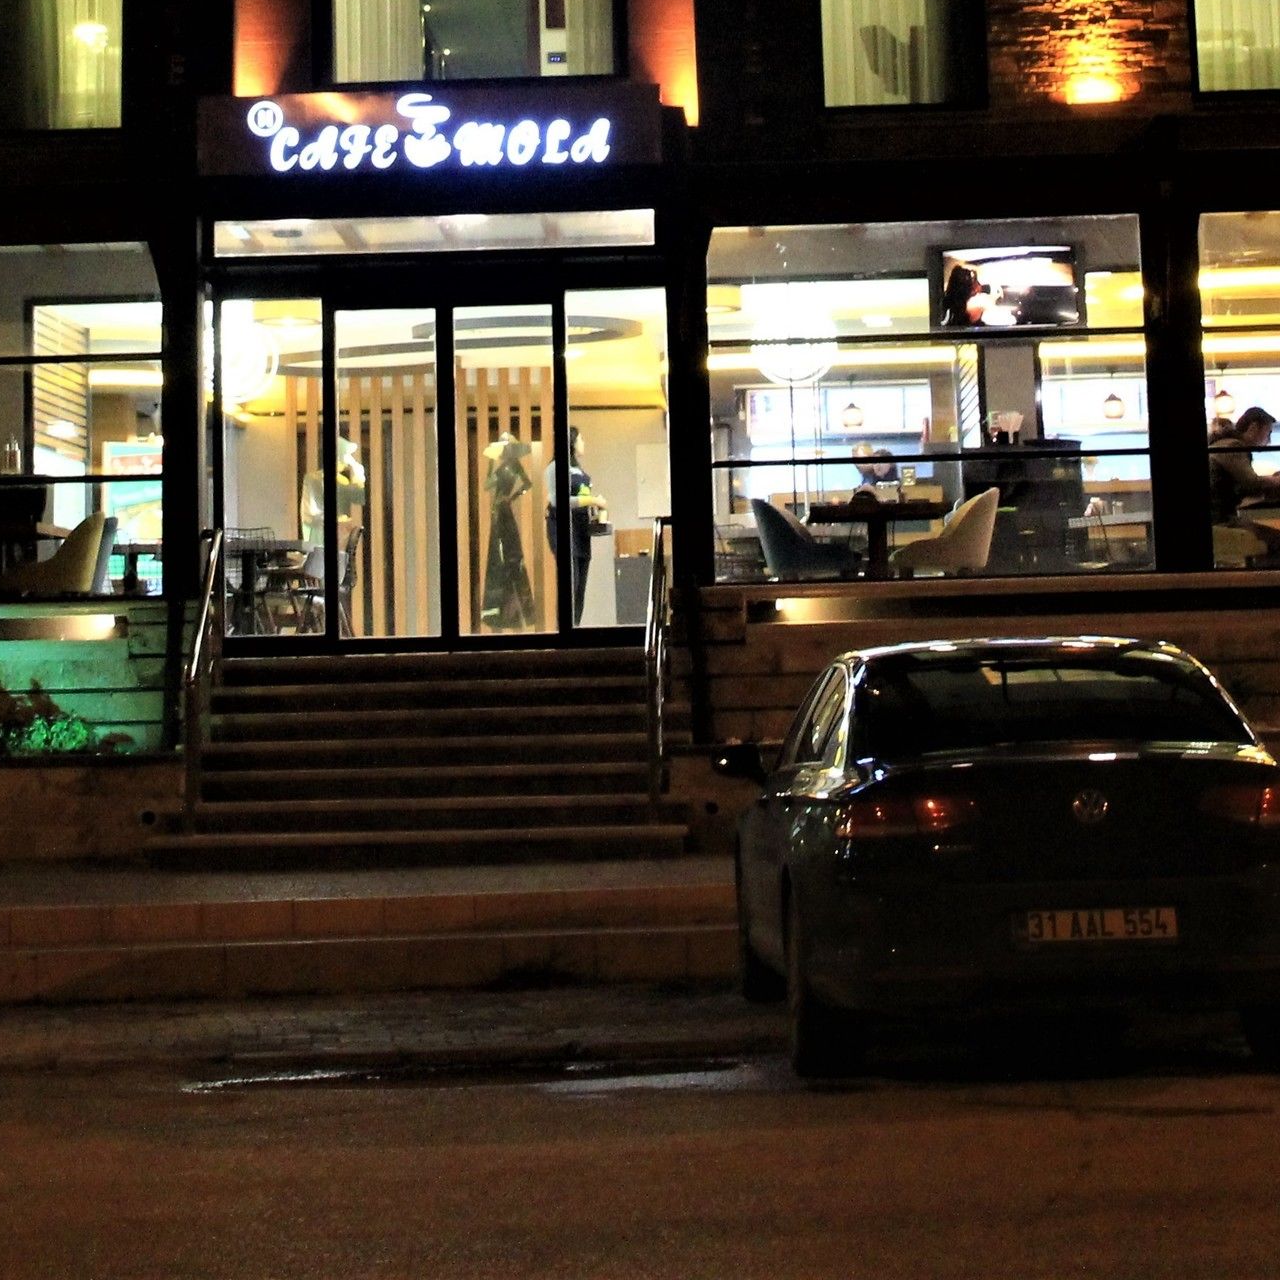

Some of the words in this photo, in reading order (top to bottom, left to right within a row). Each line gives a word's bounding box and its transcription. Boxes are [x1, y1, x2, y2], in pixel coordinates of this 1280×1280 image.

[270, 124, 400, 172] CAFE
[1029, 911, 1057, 939] 31
[1070, 910, 1115, 938] AAL
[1123, 907, 1169, 936] 554
